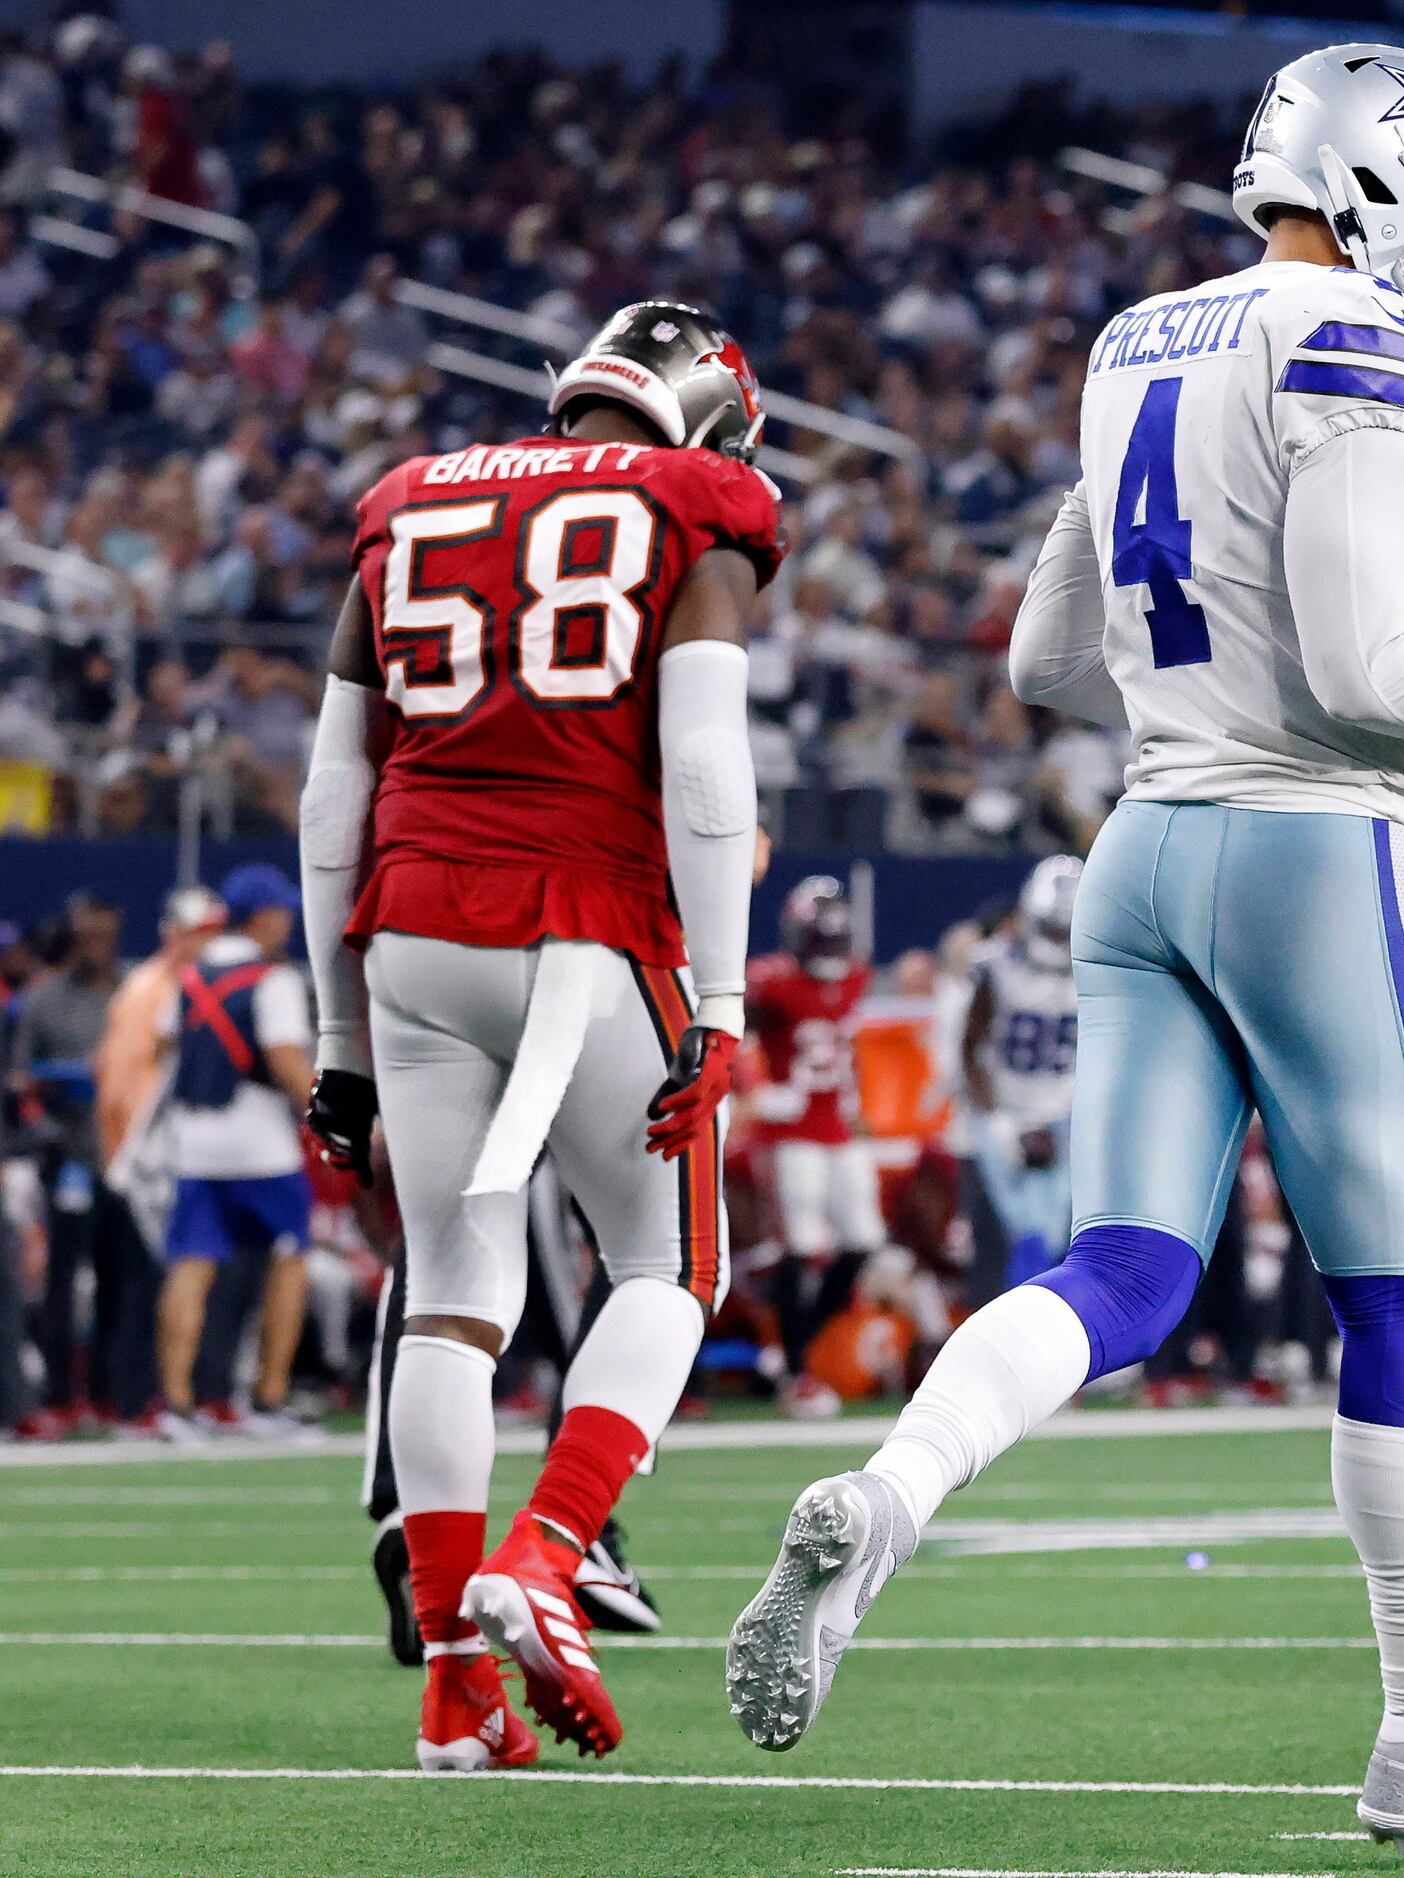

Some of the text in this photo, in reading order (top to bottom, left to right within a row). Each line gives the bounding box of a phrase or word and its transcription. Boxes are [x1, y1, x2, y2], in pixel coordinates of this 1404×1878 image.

[1092, 289, 1271, 373] PRESCOTT
[423, 442, 653, 485] BARRETT
[1112, 376, 1212, 669] 4
[381, 483, 668, 730] 58
